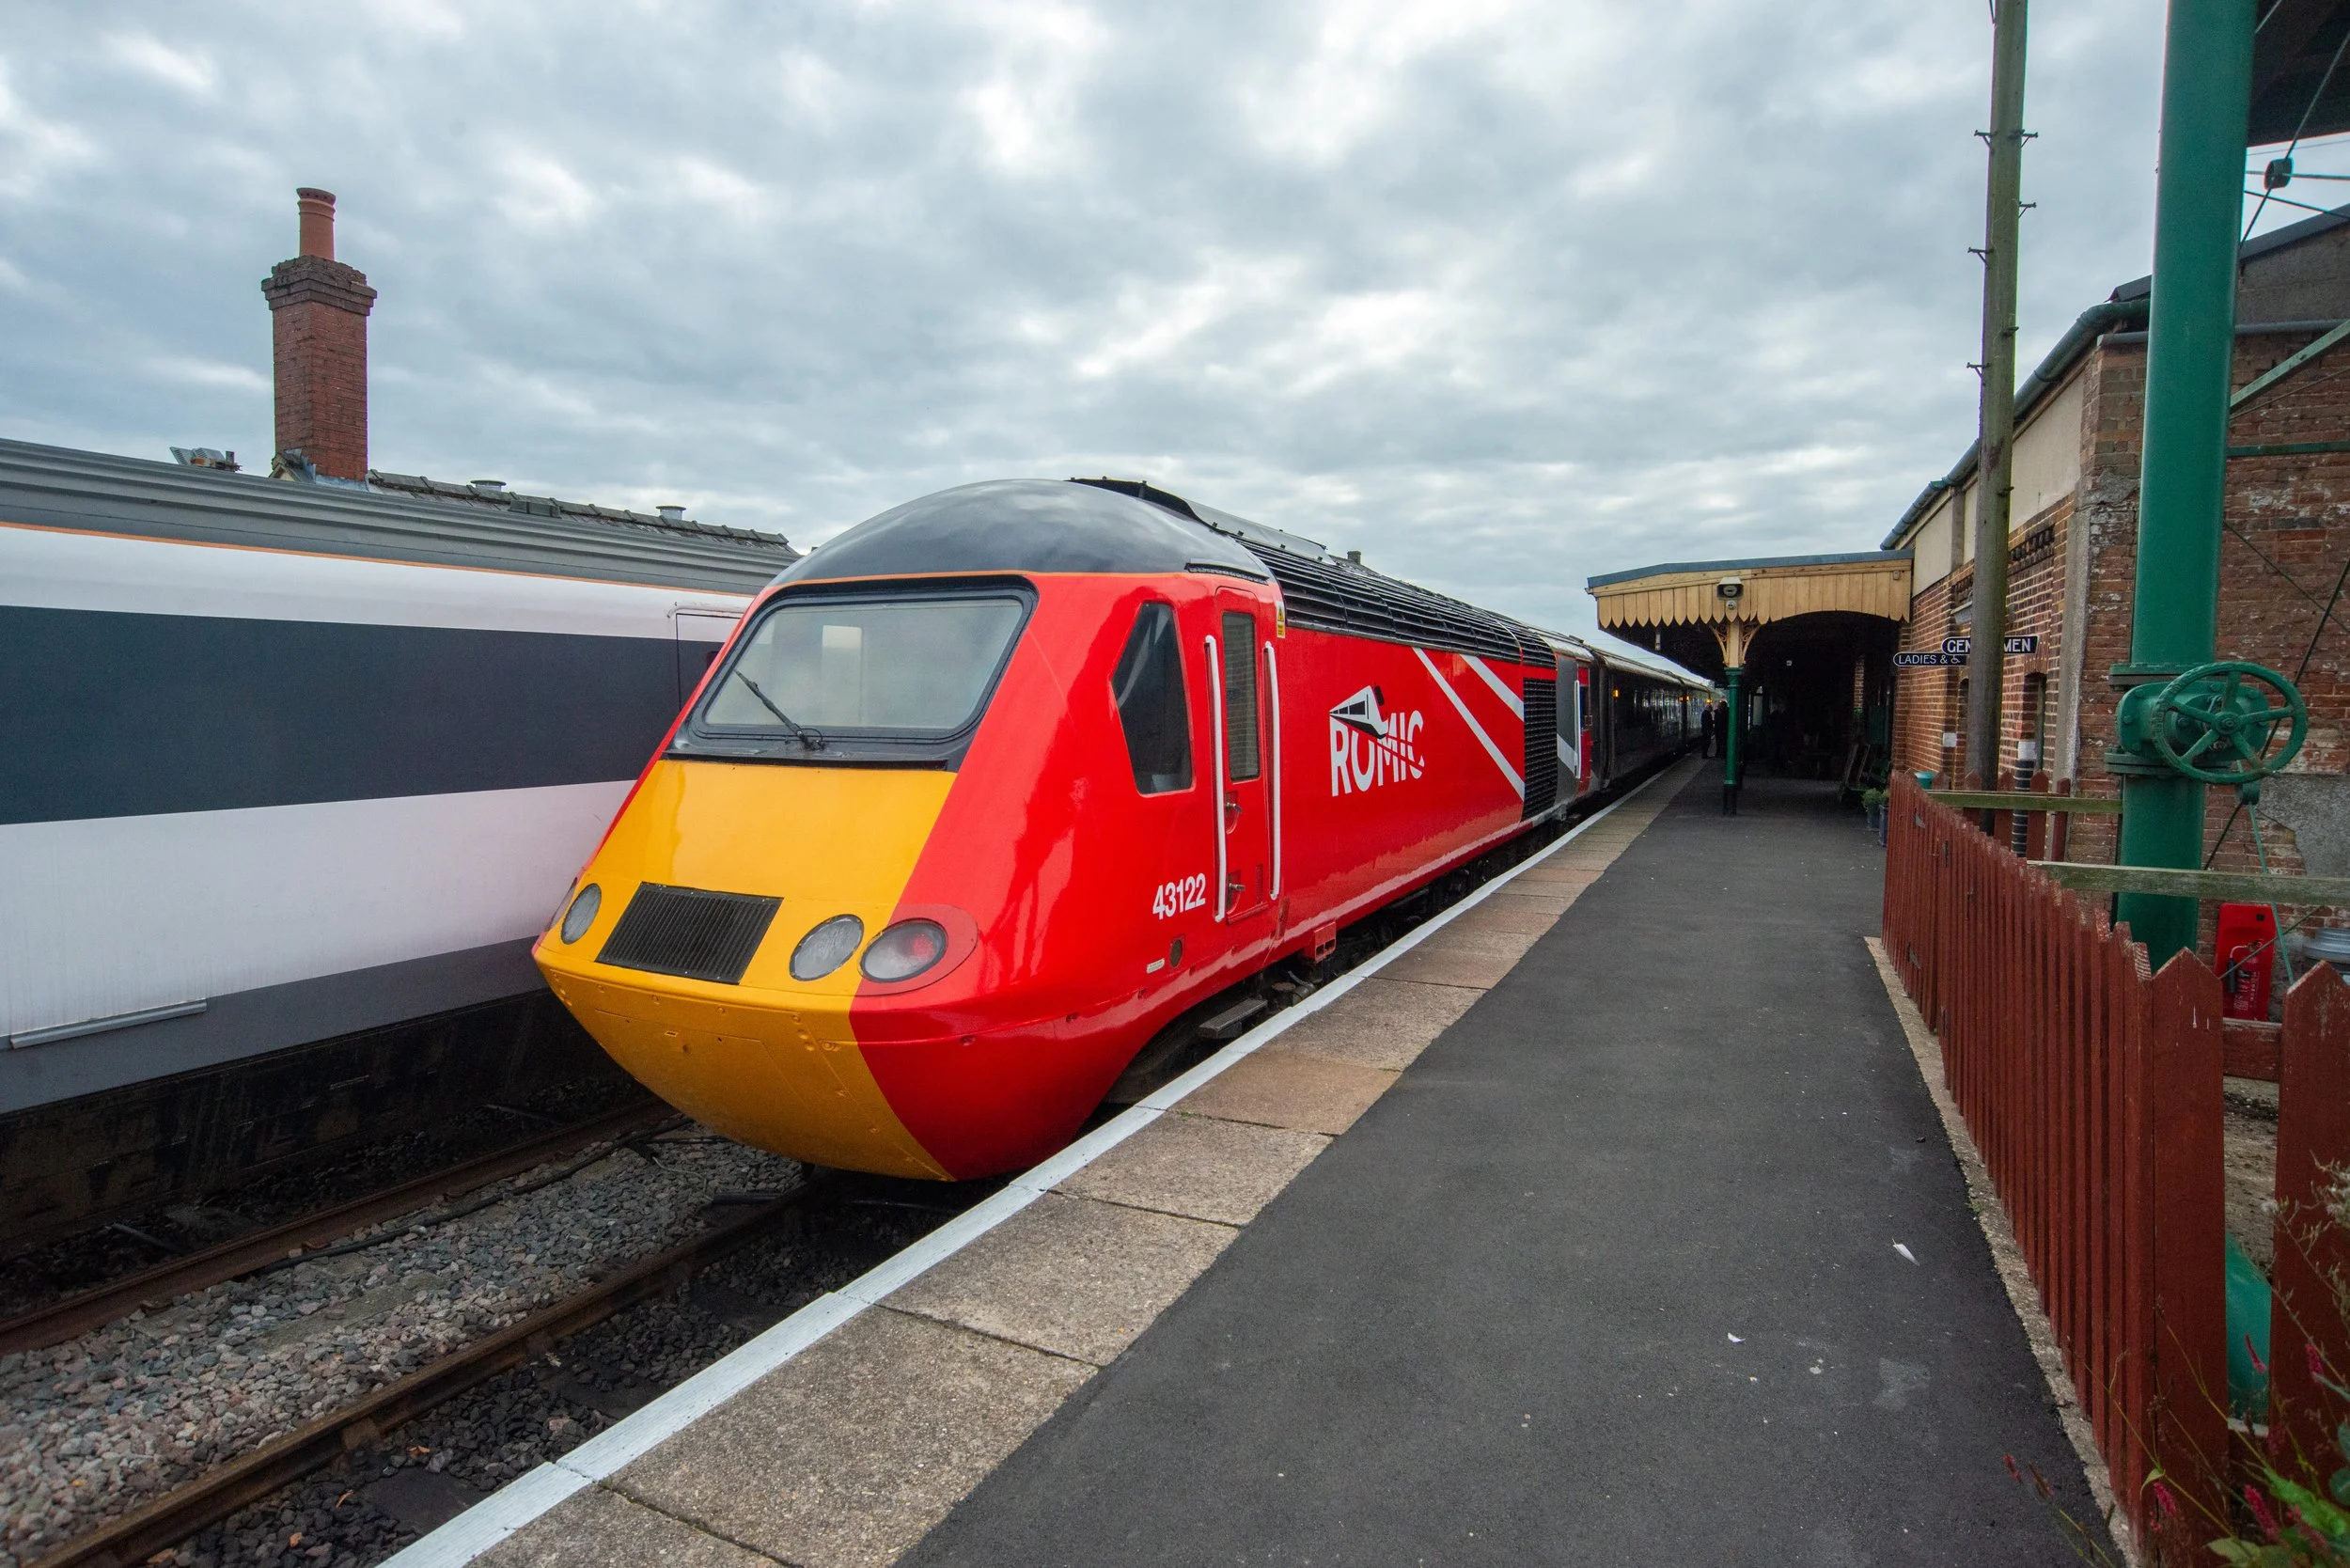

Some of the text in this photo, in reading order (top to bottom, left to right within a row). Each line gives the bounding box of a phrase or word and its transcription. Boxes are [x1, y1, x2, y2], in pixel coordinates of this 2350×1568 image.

[1947, 638, 2031, 652] GENMEN
[1899, 654, 1948, 665] LADIES &
[1152, 872, 1206, 920] 43122
